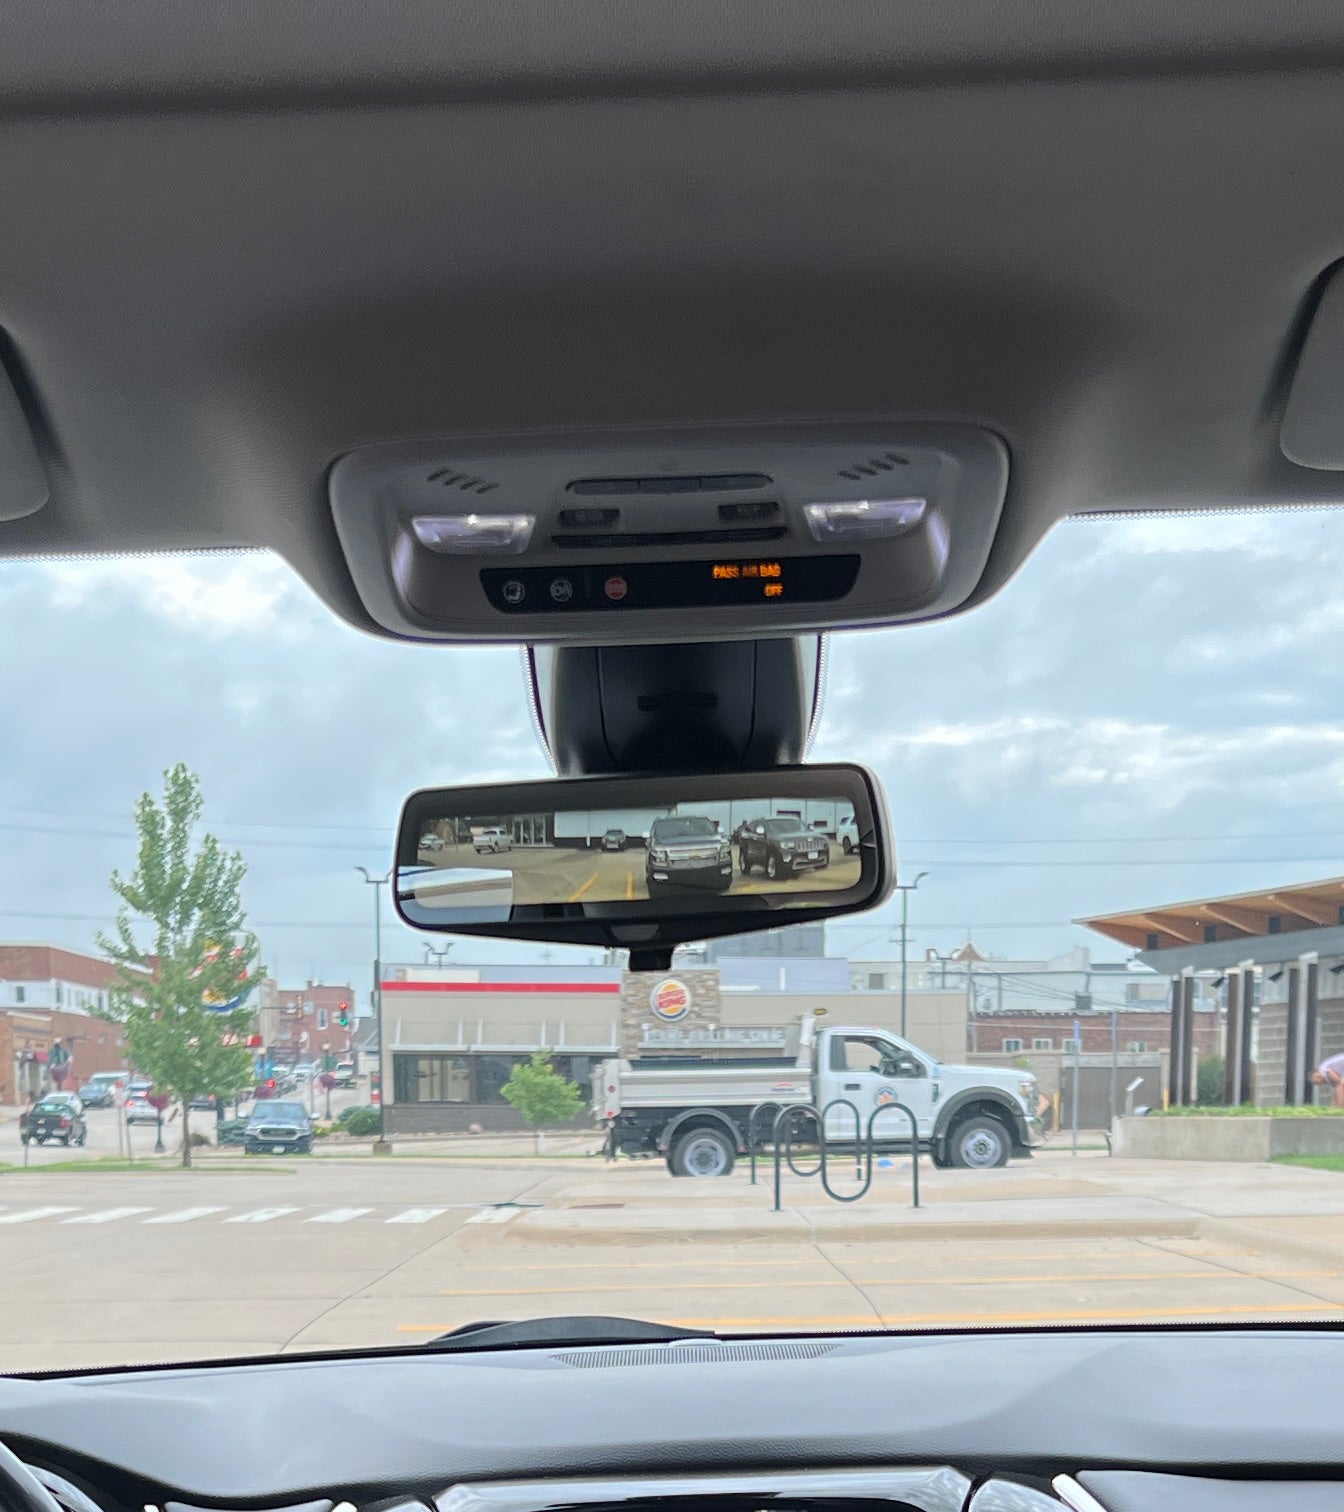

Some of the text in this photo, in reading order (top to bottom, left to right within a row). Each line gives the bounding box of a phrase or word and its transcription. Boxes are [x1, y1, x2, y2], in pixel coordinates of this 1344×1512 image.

[713, 565, 739, 578] PASS
[760, 562, 781, 577] BAG
[765, 583, 783, 597] OFF
